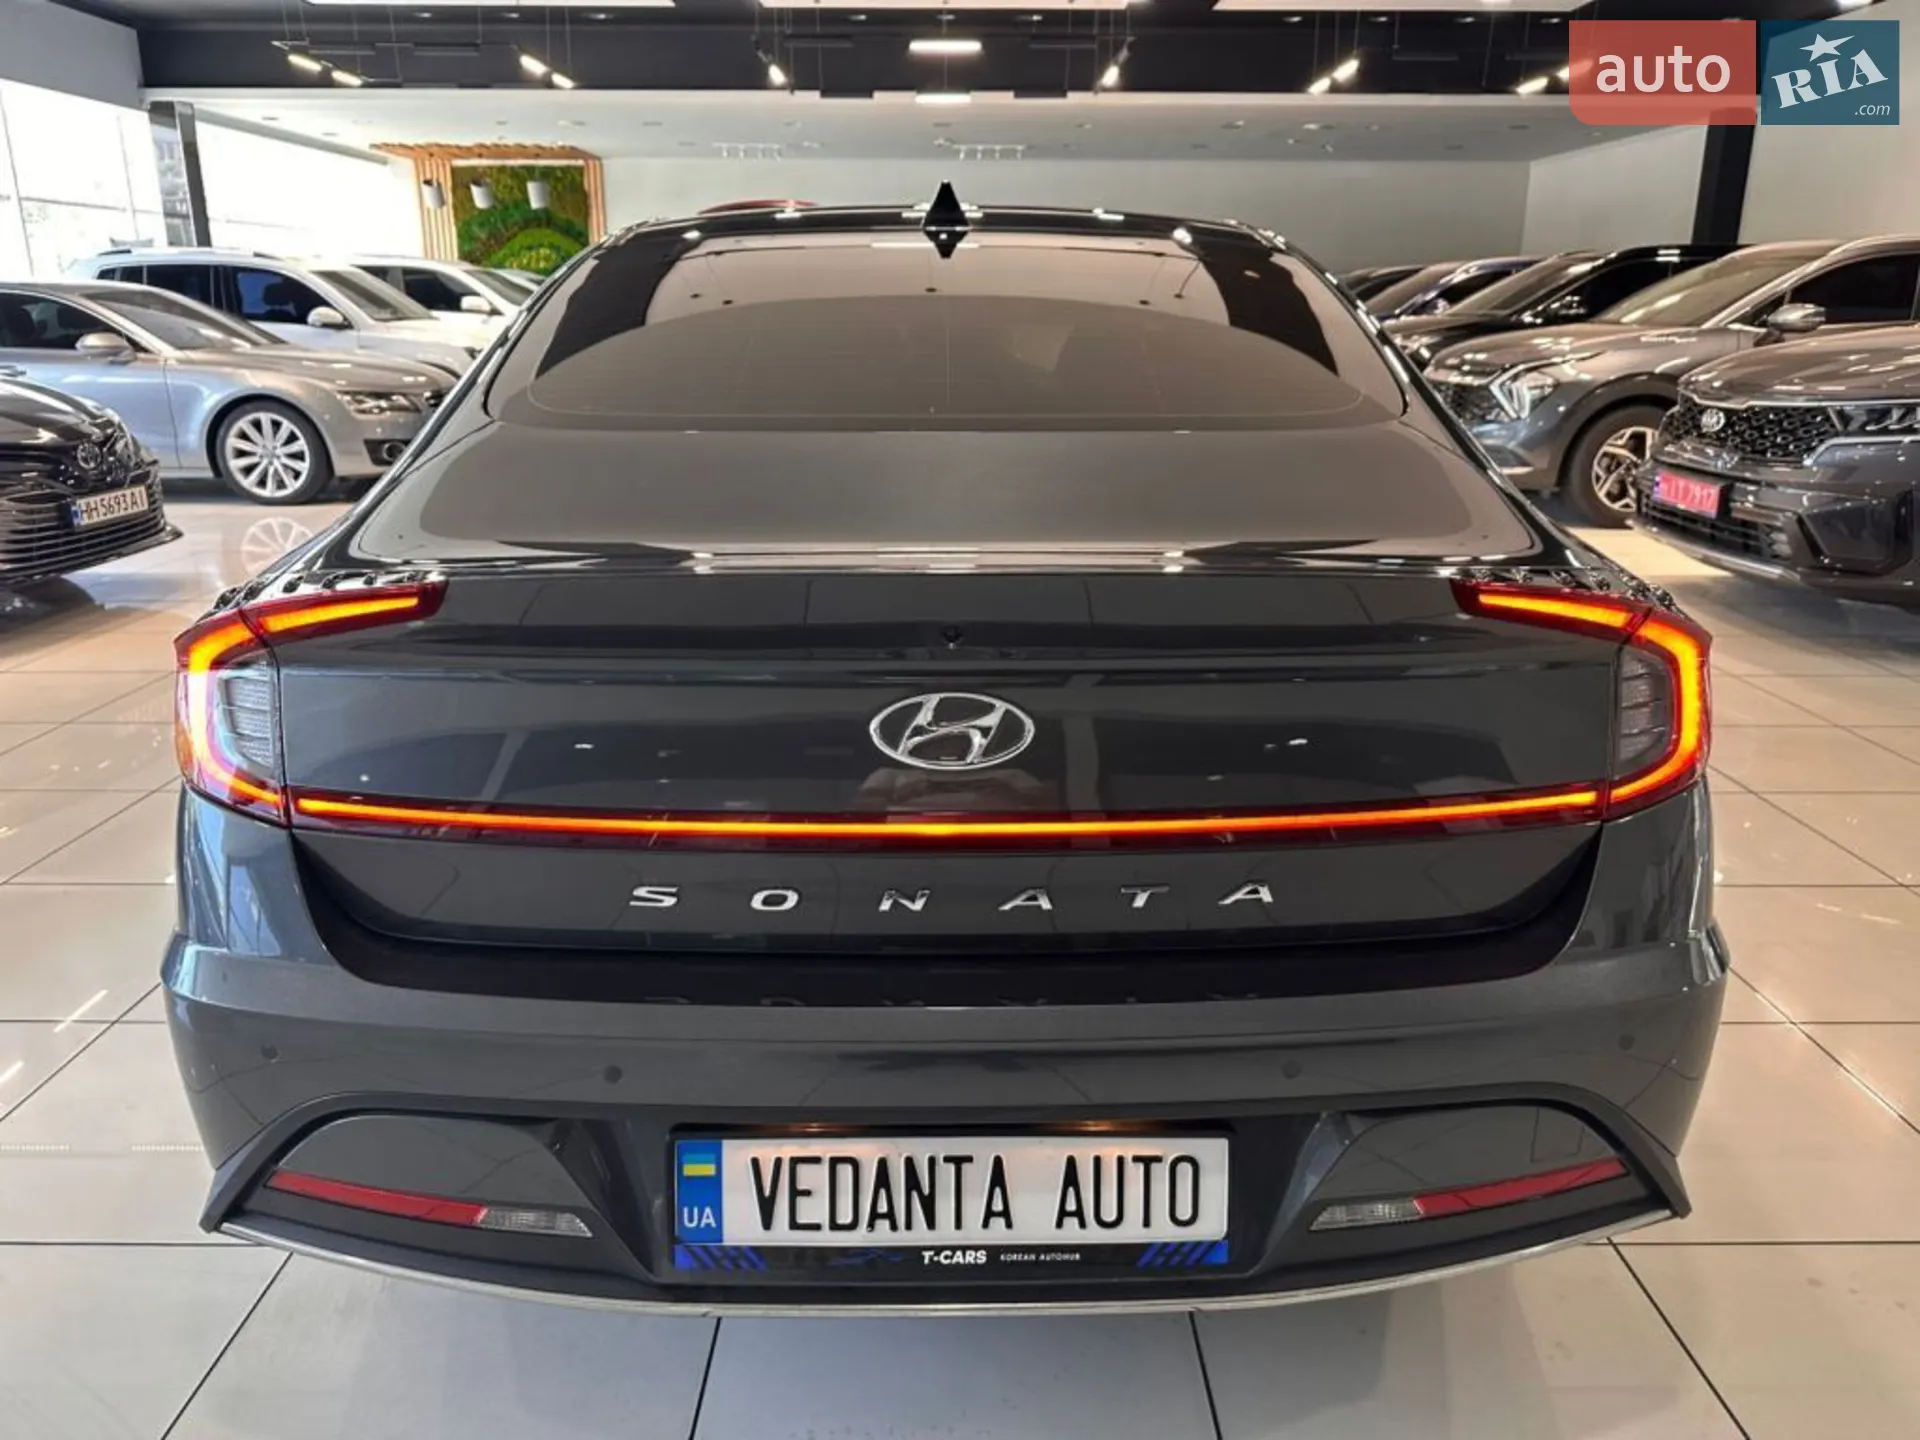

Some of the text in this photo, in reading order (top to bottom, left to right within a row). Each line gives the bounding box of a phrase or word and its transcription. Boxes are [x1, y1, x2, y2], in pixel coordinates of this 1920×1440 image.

[629, 883, 1273, 911] SONATA
[750, 1154, 1200, 1232] VEDANTA AUTO
[683, 1206, 717, 1228] UA
[921, 1250, 987, 1265] T-CARS
